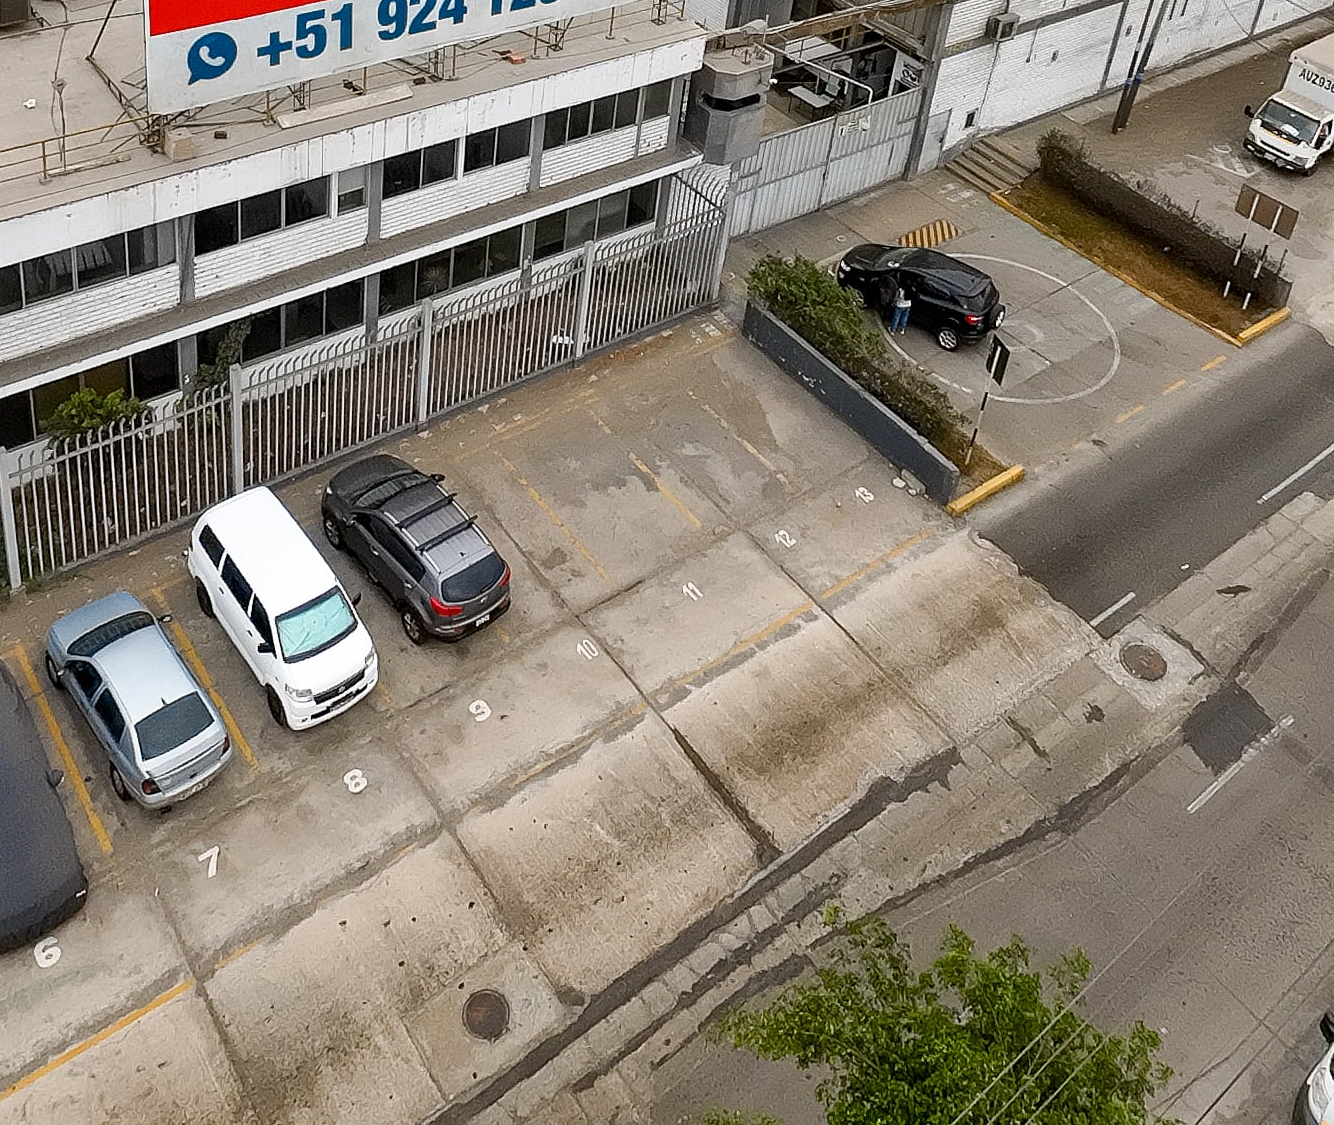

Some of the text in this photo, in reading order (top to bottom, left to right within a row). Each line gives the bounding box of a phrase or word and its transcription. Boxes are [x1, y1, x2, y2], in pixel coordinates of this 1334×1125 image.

[257, 3, 354, 67] +51
[854, 486, 875, 504] 13
[774, 529, 797, 549] 12
[681, 580, 703, 602] 11
[576, 638, 599, 660] 10
[468, 699, 492, 722] 9
[343, 768, 368, 794] 8
[198, 845, 220, 878] 7
[33, 936, 62, 969] 6
